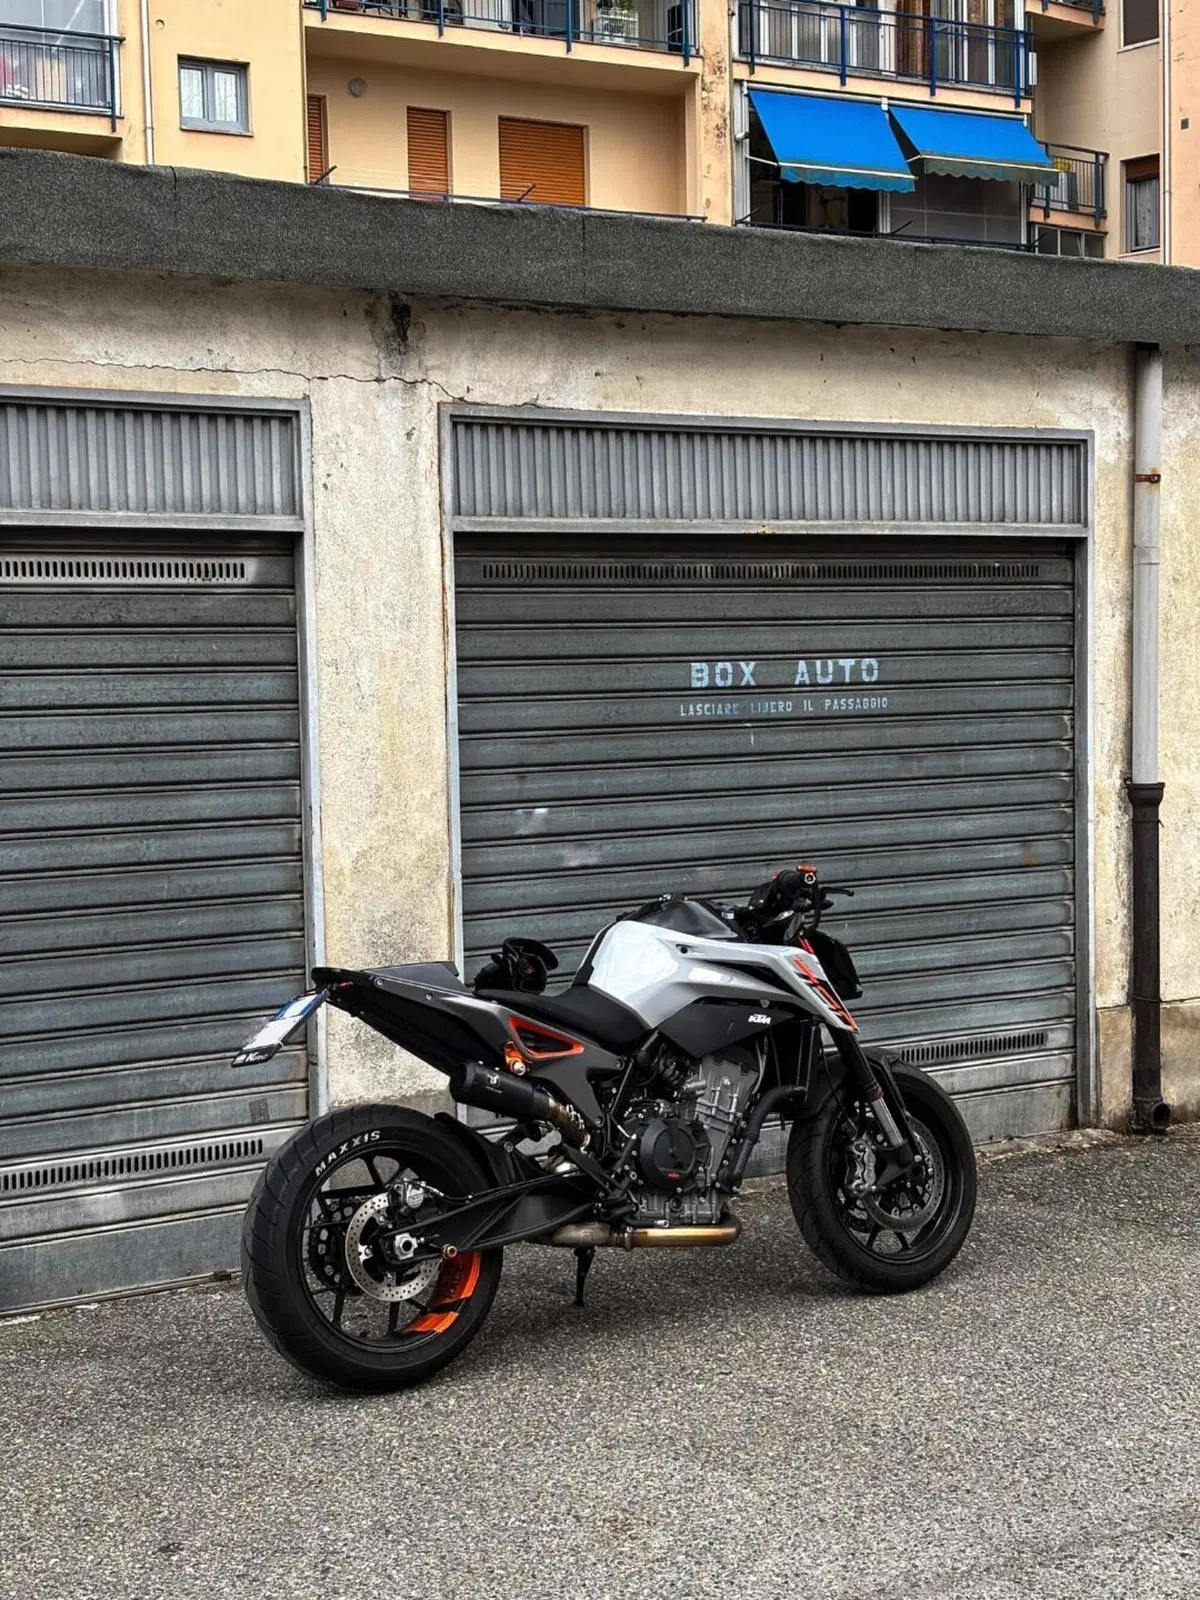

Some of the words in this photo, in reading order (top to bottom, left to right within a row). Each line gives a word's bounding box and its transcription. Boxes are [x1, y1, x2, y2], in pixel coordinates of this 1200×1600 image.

[690, 661, 757, 688] BOX
[794, 658, 879, 684] AUTO
[680, 703, 740, 717] LASCIARE
[750, 701, 793, 714] LIBERO
[803, 699, 814, 712] IL
[825, 696, 888, 711] PASSAGGIO
[747, 1013, 772, 1025] KTM
[315, 1130, 381, 1177] MAXXIS
